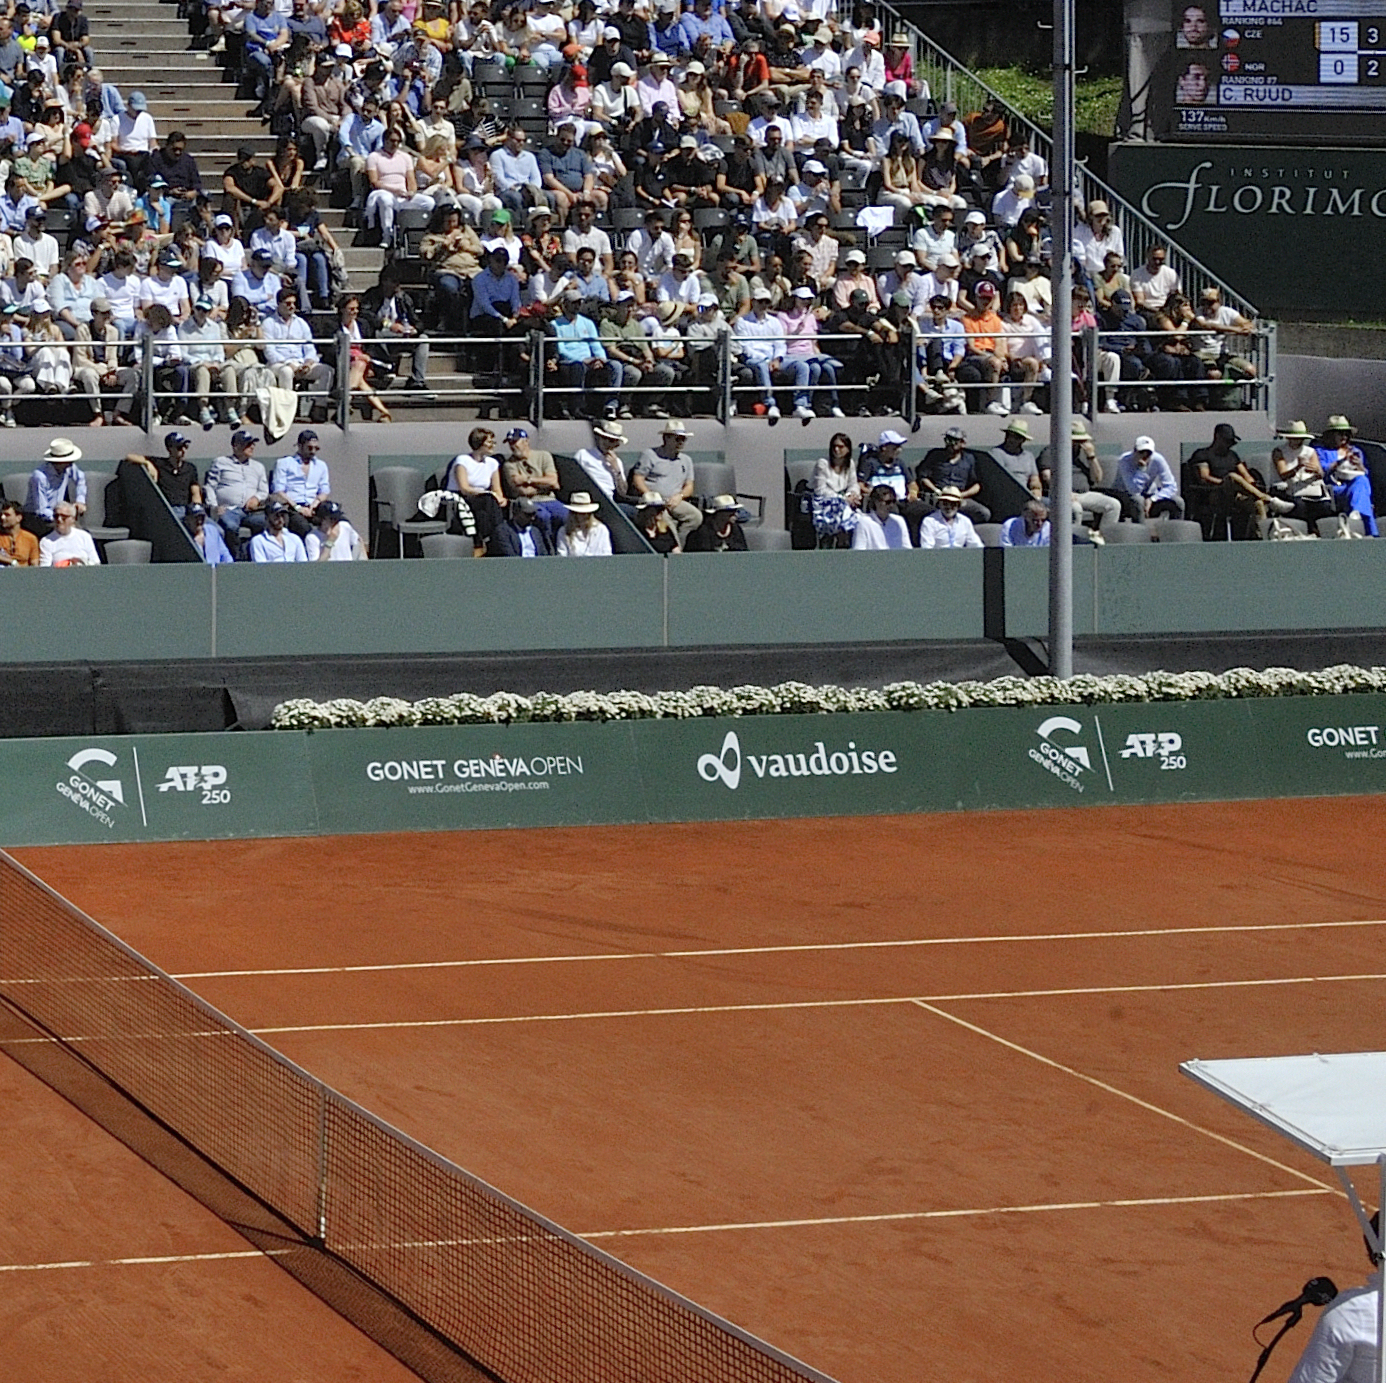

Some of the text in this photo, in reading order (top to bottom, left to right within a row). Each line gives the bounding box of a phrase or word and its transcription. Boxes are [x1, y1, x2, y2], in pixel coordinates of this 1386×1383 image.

[1223, 0, 1318, 13] T. MACHAC
[1221, 17, 1265, 25] RANKING
[1244, 29, 1263, 38] CZE
[1330, 27, 1379, 43] 15 3
[1244, 63, 1265, 71] NOR
[1333, 59, 1379, 76] 0 2
[1221, 75, 1265, 84] RANKING
[1222, 88, 1293, 101] C. RUUD
[1230, 168, 1350, 179] INSTITUT
[1307, 726, 1379, 747] GONET
[1118, 732, 1182, 758] ATP
[746, 741, 898, 778] vaudoise
[1040, 742, 1084, 777] GONET
[1160, 756, 1187, 770] 250
[366, 759, 446, 781] GONET
[530, 755, 584, 776] OPEN
[154, 765, 227, 792] ATP
[69, 775, 116, 812] GONET
[407, 781, 550, 795] www.GonetGenevaOpen.com
[201, 790, 231, 804] 250
